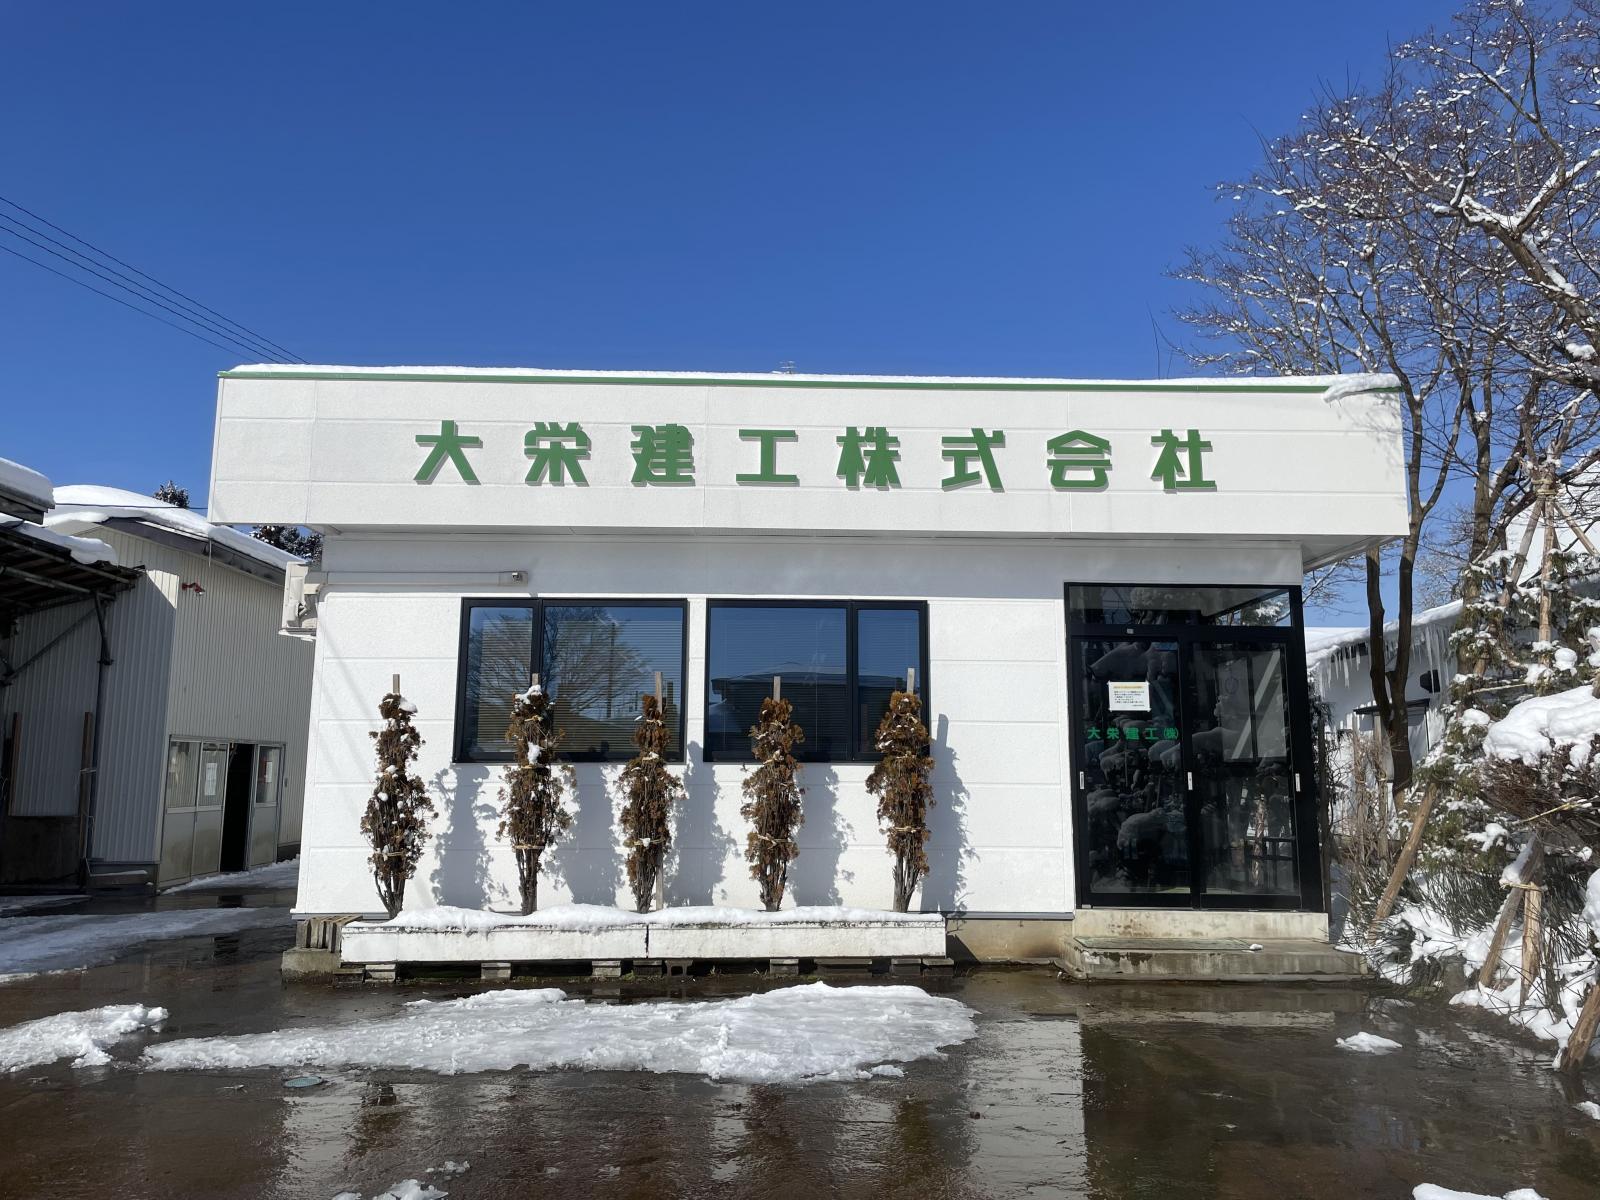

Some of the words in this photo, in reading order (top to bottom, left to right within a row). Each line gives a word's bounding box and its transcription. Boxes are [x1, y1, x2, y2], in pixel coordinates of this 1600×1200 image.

[413, 419, 1217, 493] 大栄建工株式会社
